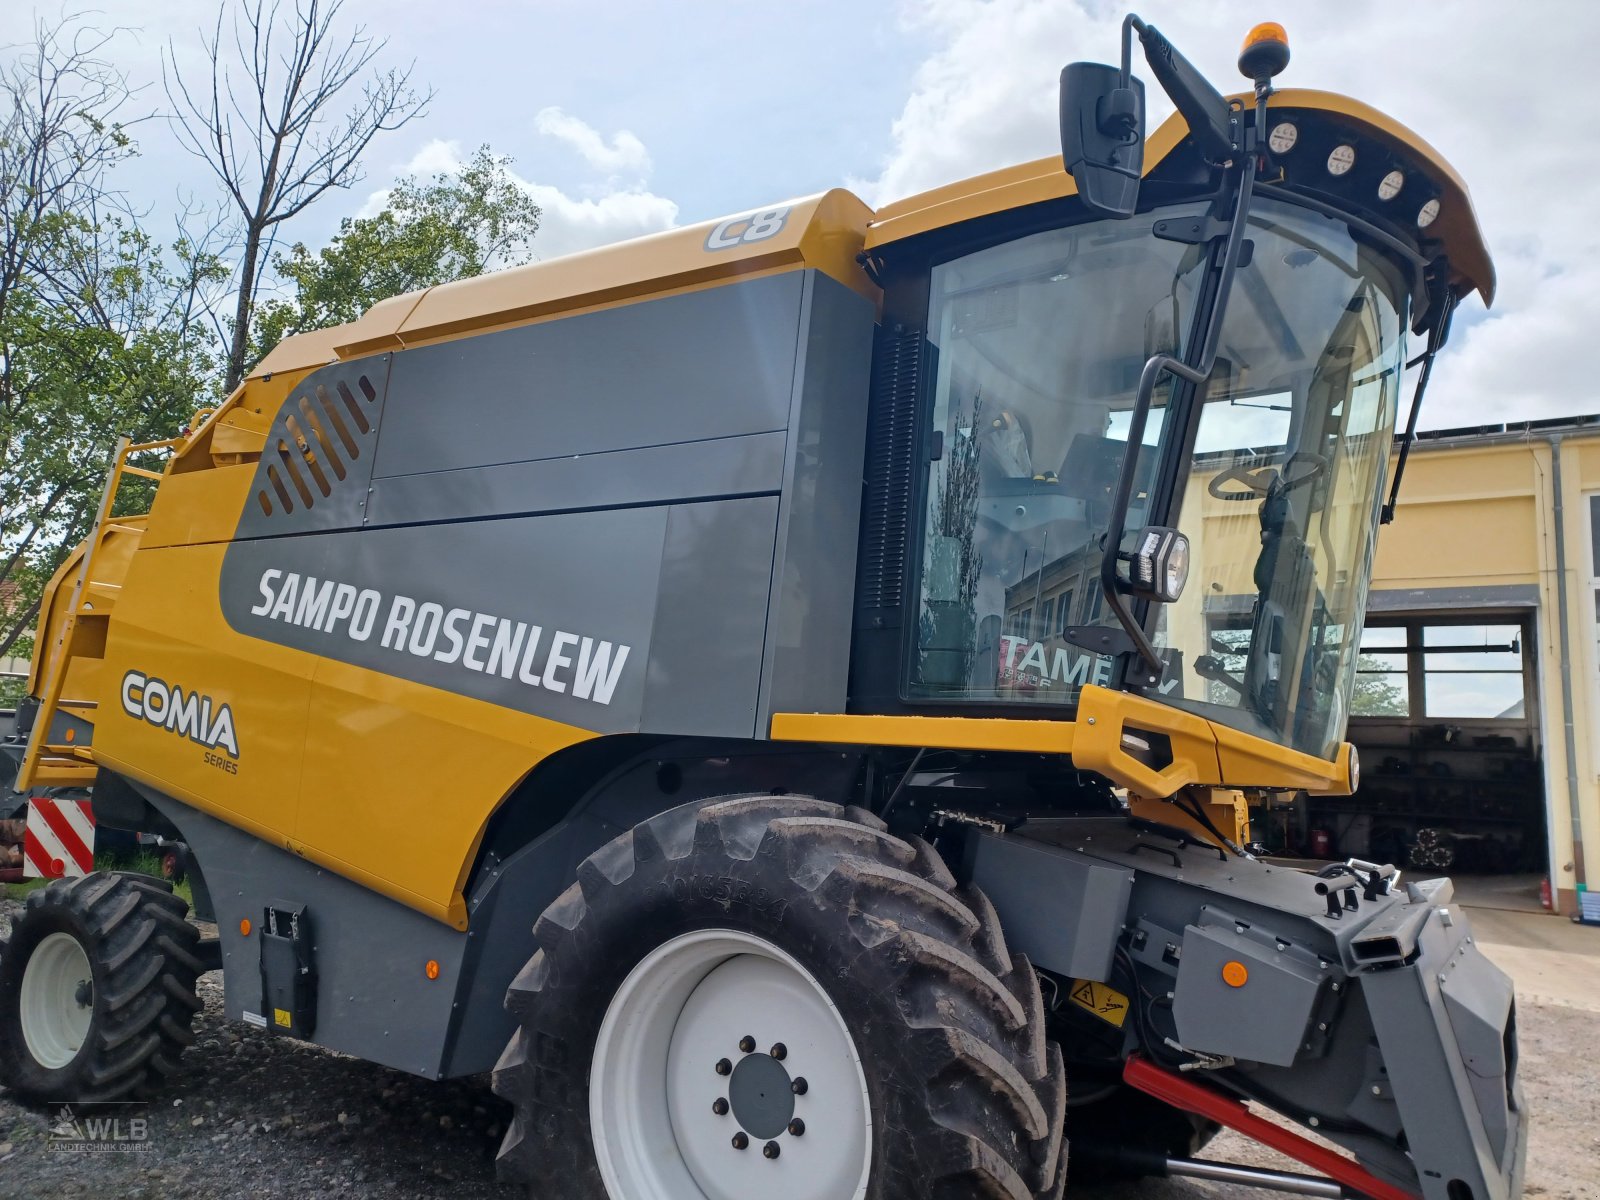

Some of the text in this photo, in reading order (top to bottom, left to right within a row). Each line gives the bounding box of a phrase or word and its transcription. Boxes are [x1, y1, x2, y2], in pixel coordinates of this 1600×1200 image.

[705, 207, 790, 250] C8
[251, 568, 631, 705] SAMPO ROSENLEW
[121, 670, 239, 759] COMIA
[203, 751, 239, 776] SERIES
